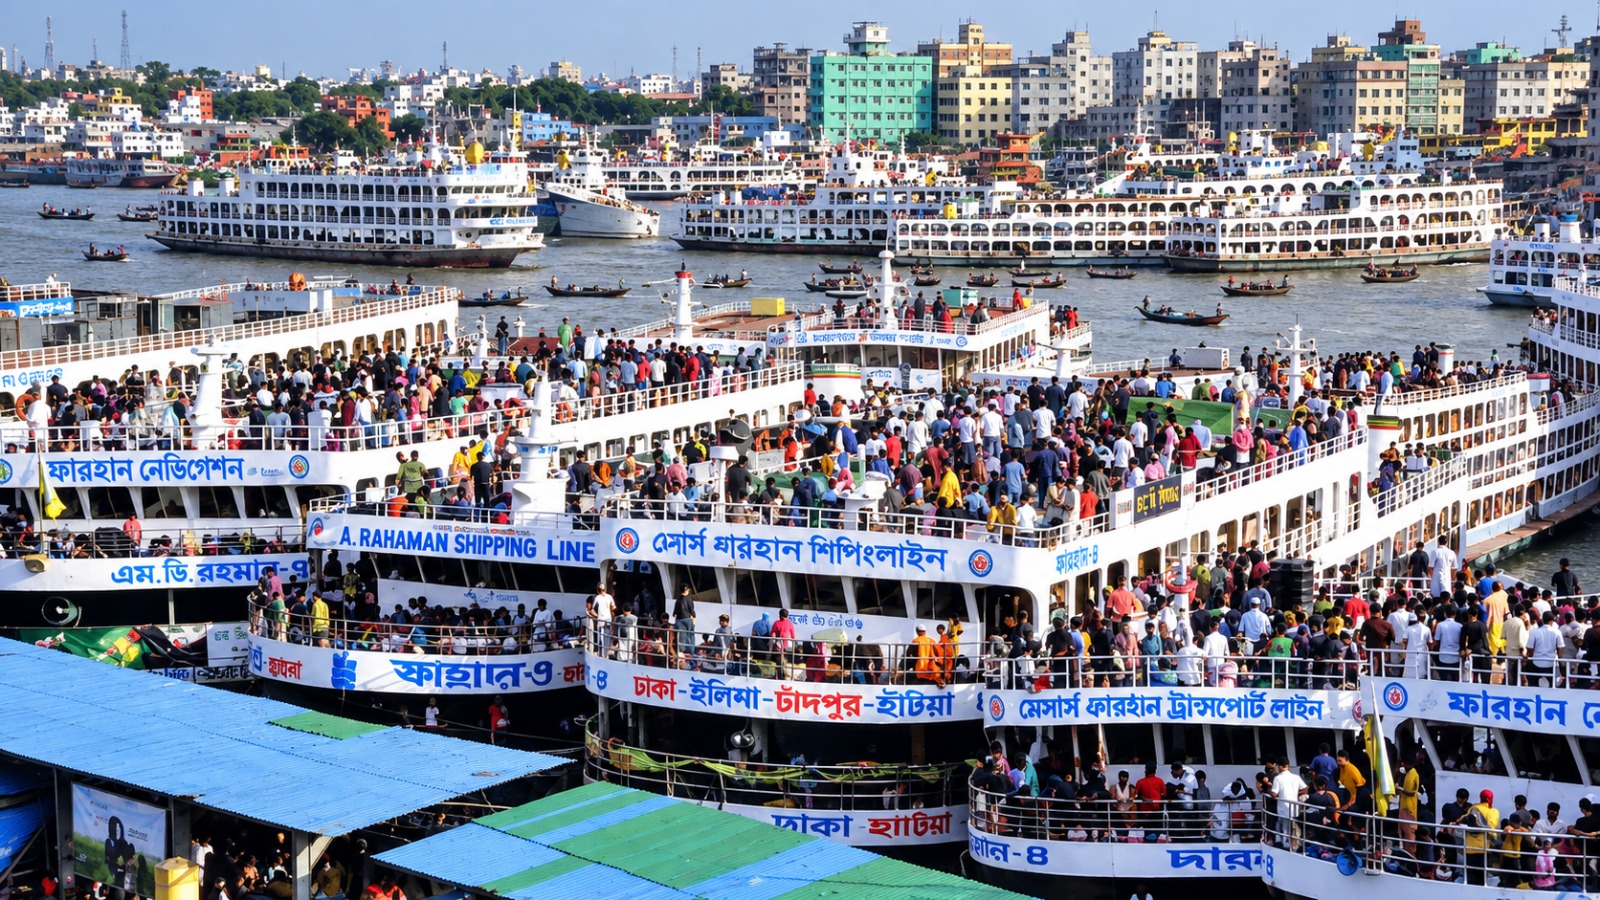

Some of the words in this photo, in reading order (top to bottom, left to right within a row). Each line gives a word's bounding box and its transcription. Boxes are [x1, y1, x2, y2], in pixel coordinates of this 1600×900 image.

[46, 457, 133, 482] ফারহান
[340, 525, 356, 547] A.
[359, 527, 450, 552] RAHAMAN
[454, 533, 537, 559] SHIPPING
[547, 539, 596, 563] LINE
[1019, 692, 1081, 719] মেসার্স
[1086, 693, 1163, 718] ফারহান
[1270, 693, 1325, 721] লাইন
[1447, 689, 1568, 727] ফারহান
